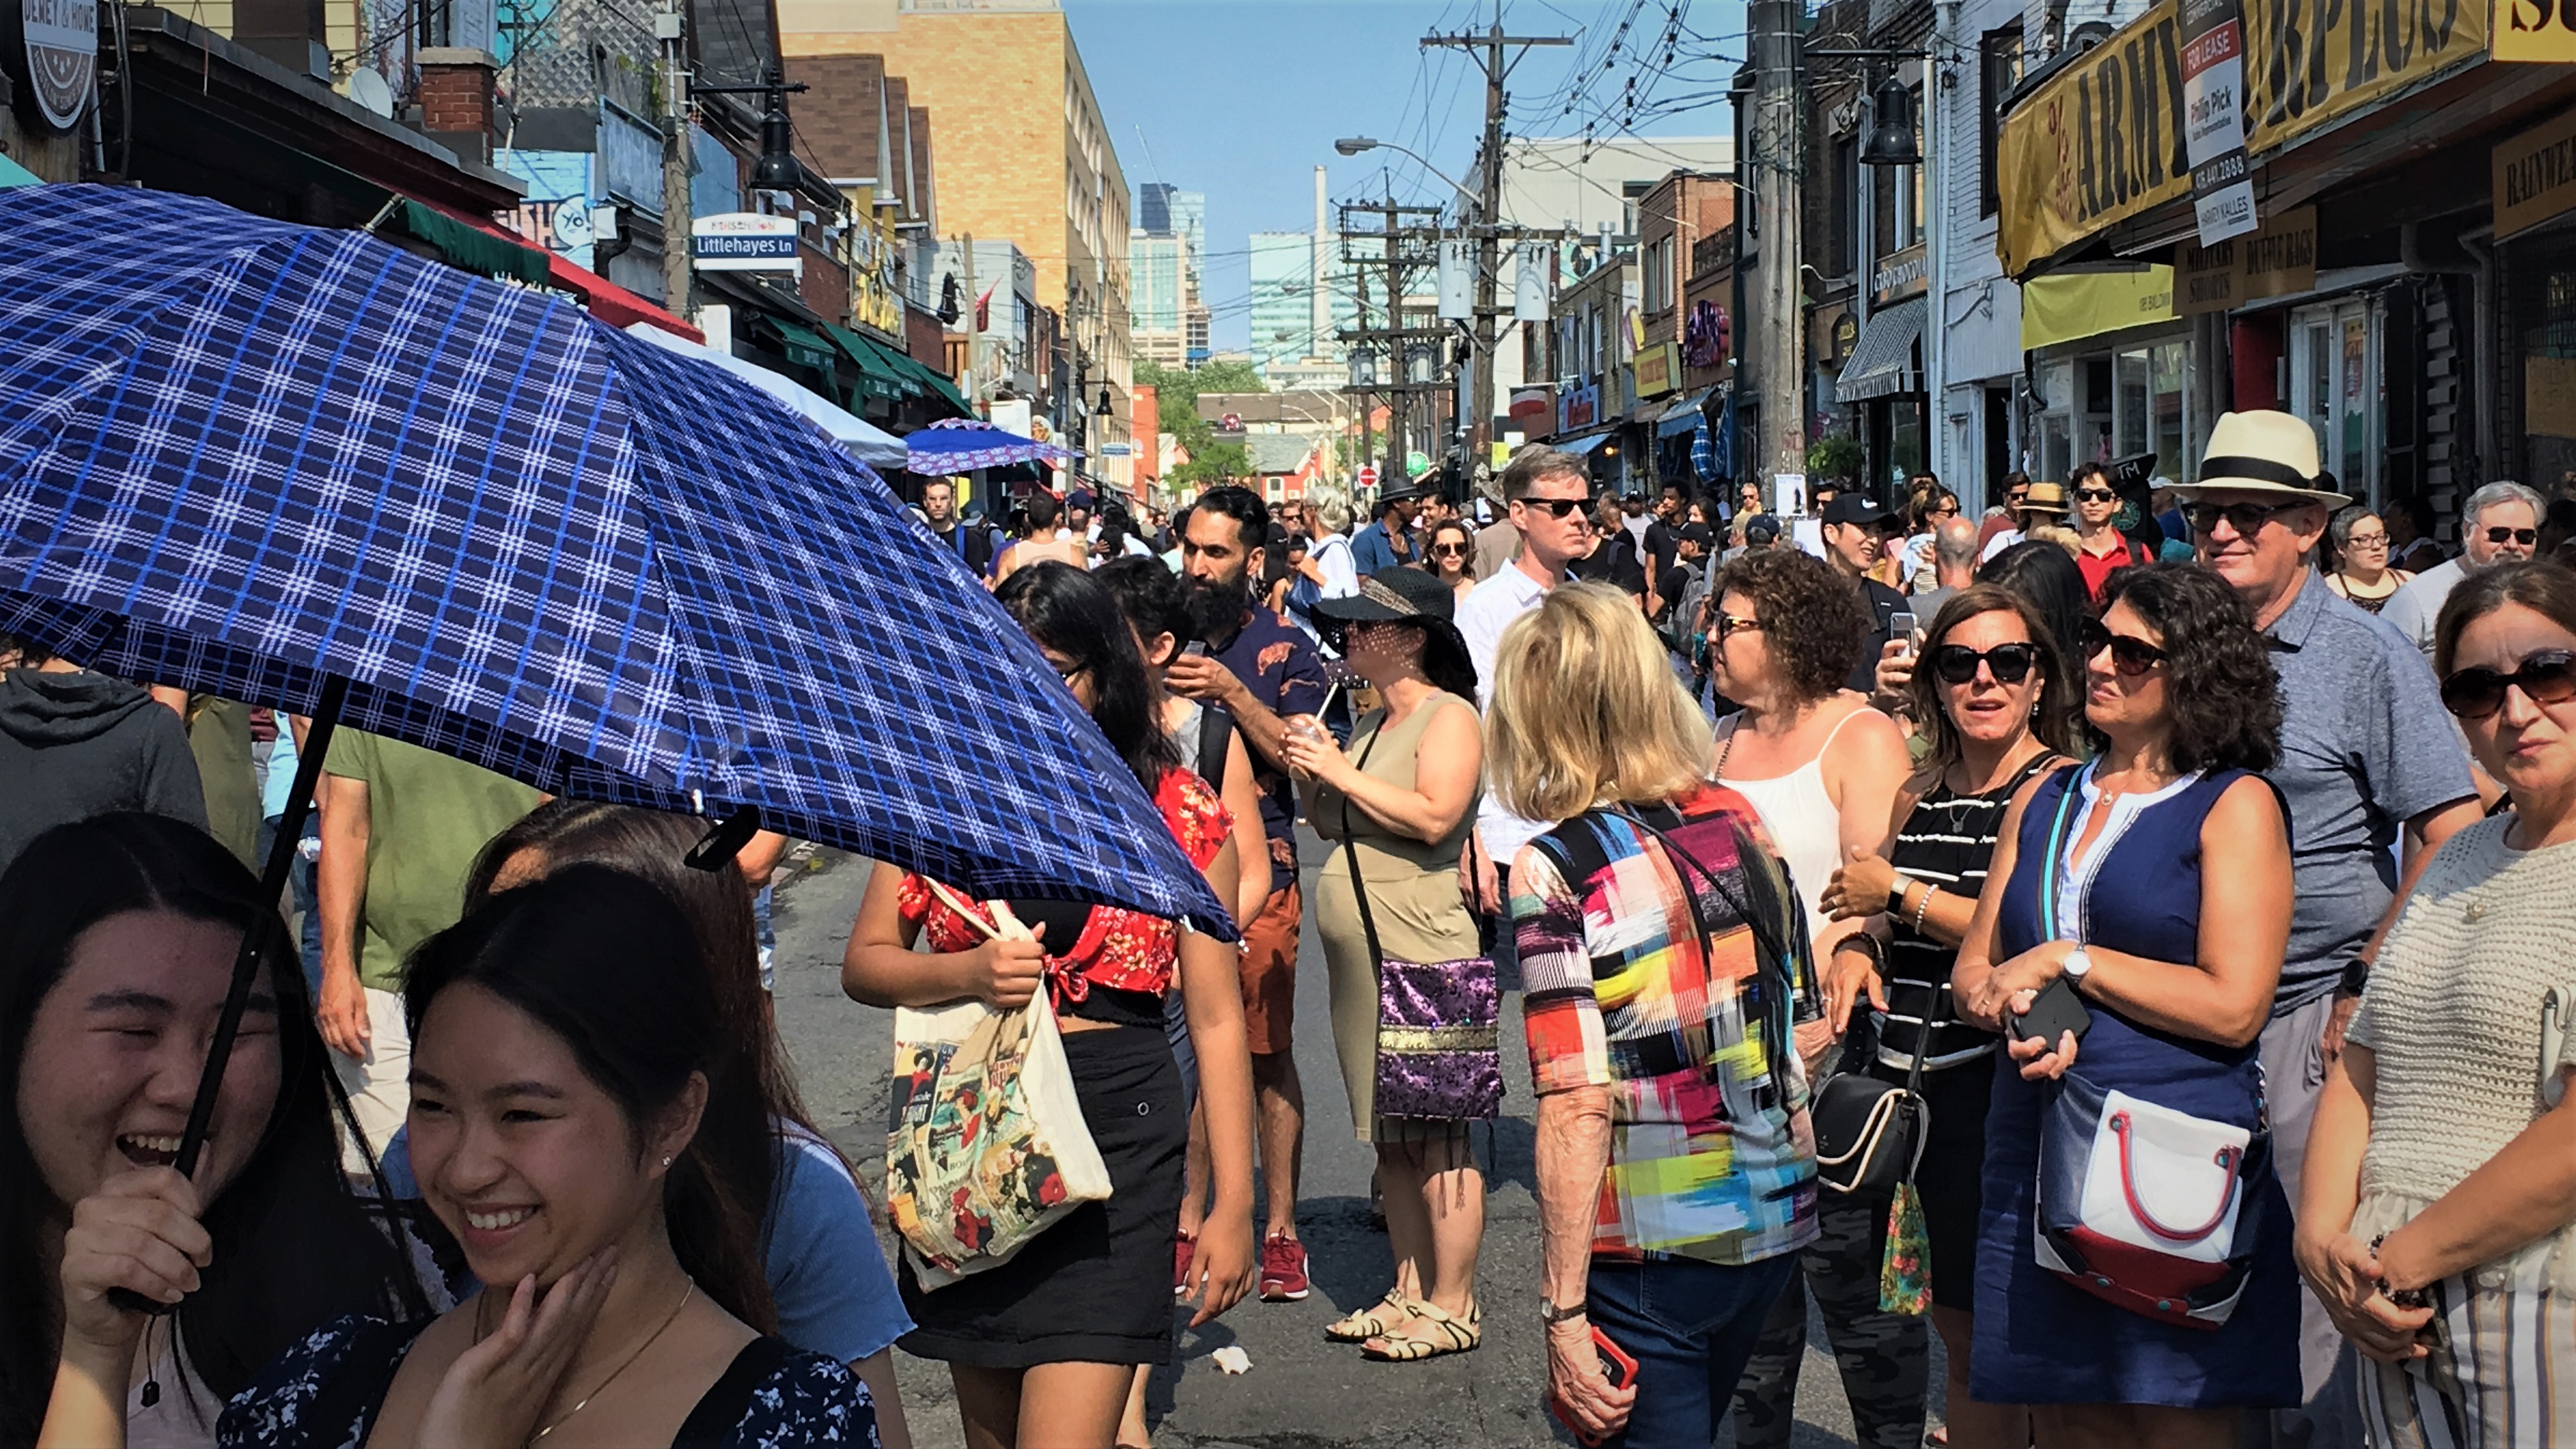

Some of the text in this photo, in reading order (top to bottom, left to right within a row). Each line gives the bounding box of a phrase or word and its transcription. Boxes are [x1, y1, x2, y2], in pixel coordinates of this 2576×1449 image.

[62, 0, 69, 28] &
[2187, 31, 2231, 72] FOR LEASE
[2078, 0, 2457, 223] ARMY URPLU
[2211, 85, 2232, 114] Pick
[698, 237, 792, 256] Littlehayes Ln
[2118, 461, 2141, 480] TM
